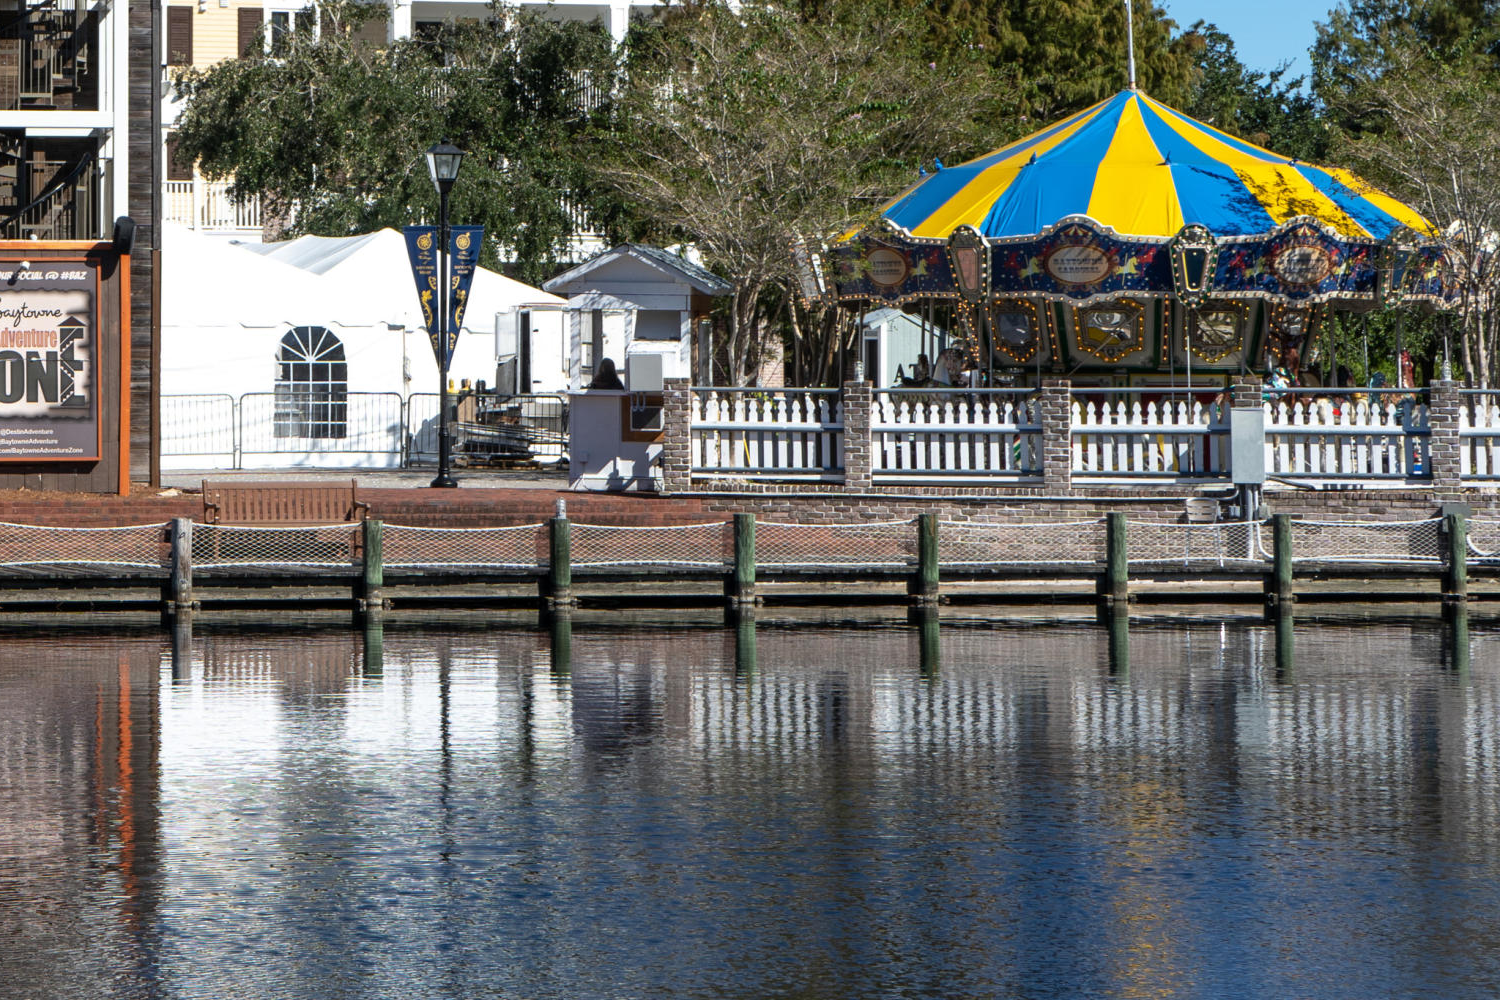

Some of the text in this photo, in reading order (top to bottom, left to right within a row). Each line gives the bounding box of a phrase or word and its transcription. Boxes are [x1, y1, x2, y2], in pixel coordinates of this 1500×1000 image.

[17, 271, 44, 281] OCIAL
[45, 271, 59, 281] @
[60, 271, 88, 281] #BAZ
